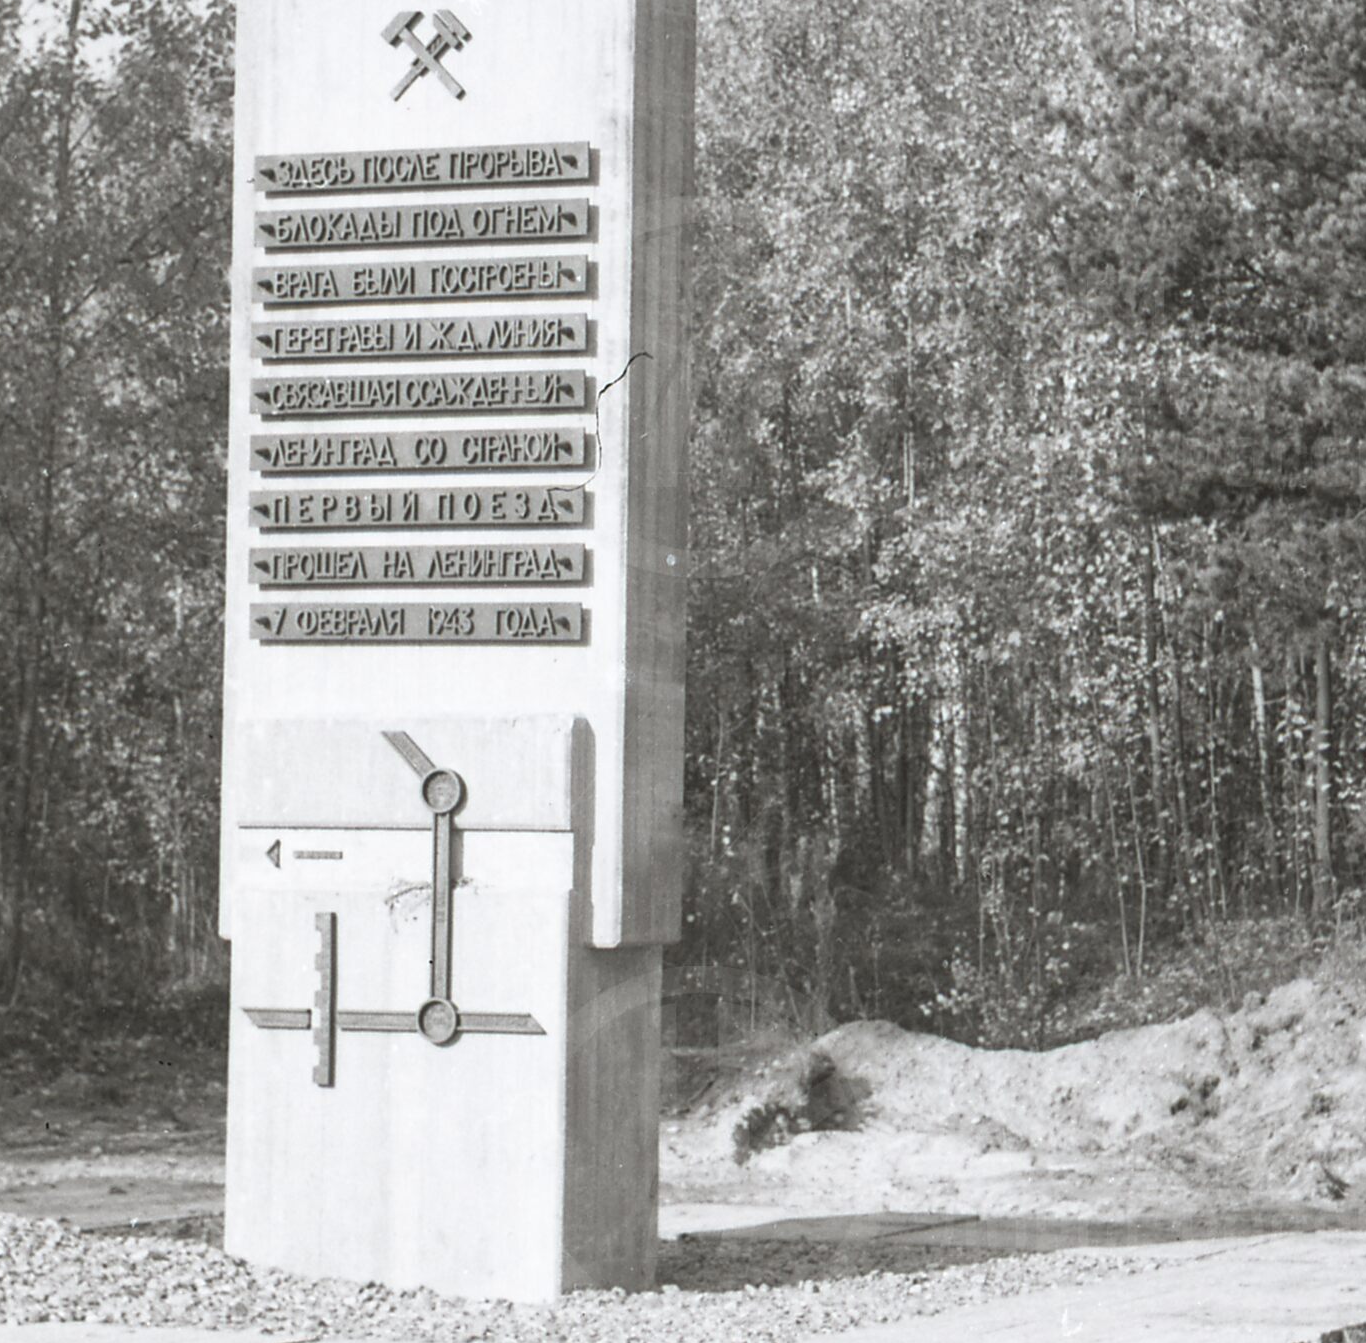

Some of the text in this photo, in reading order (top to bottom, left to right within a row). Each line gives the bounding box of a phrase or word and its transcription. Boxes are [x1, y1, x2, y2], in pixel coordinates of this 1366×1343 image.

[278, 148, 565, 188] ЗДЕСЬ ПОСЛЕ ПРОРЫВА
[275, 204, 563, 244] БЛОКАДЫ ПОД ОГНЕМ
[273, 259, 562, 299] ВРАГА БЫЛИ ПОСТРОЕНЫ
[272, 323, 395, 354] ПЕРЕПРАВЫ
[404, 323, 422, 351] И
[487, 318, 562, 348] ЛИНИЯ
[271, 373, 561, 411] СВЯЗАВШАЯ ОСАЖДЕННЫЙ
[270, 431, 561, 467] ЛЕНИНГРАД СО СТРАНОЙ
[273, 490, 559, 524] ПЕРВЫЙ ПОЕЗД
[271, 547, 561, 580] ПРОШЕЛ НА ЛЕНИНГРАД
[273, 606, 557, 637] 7 ФЕВРАЛЯ 1943 ГОДА
